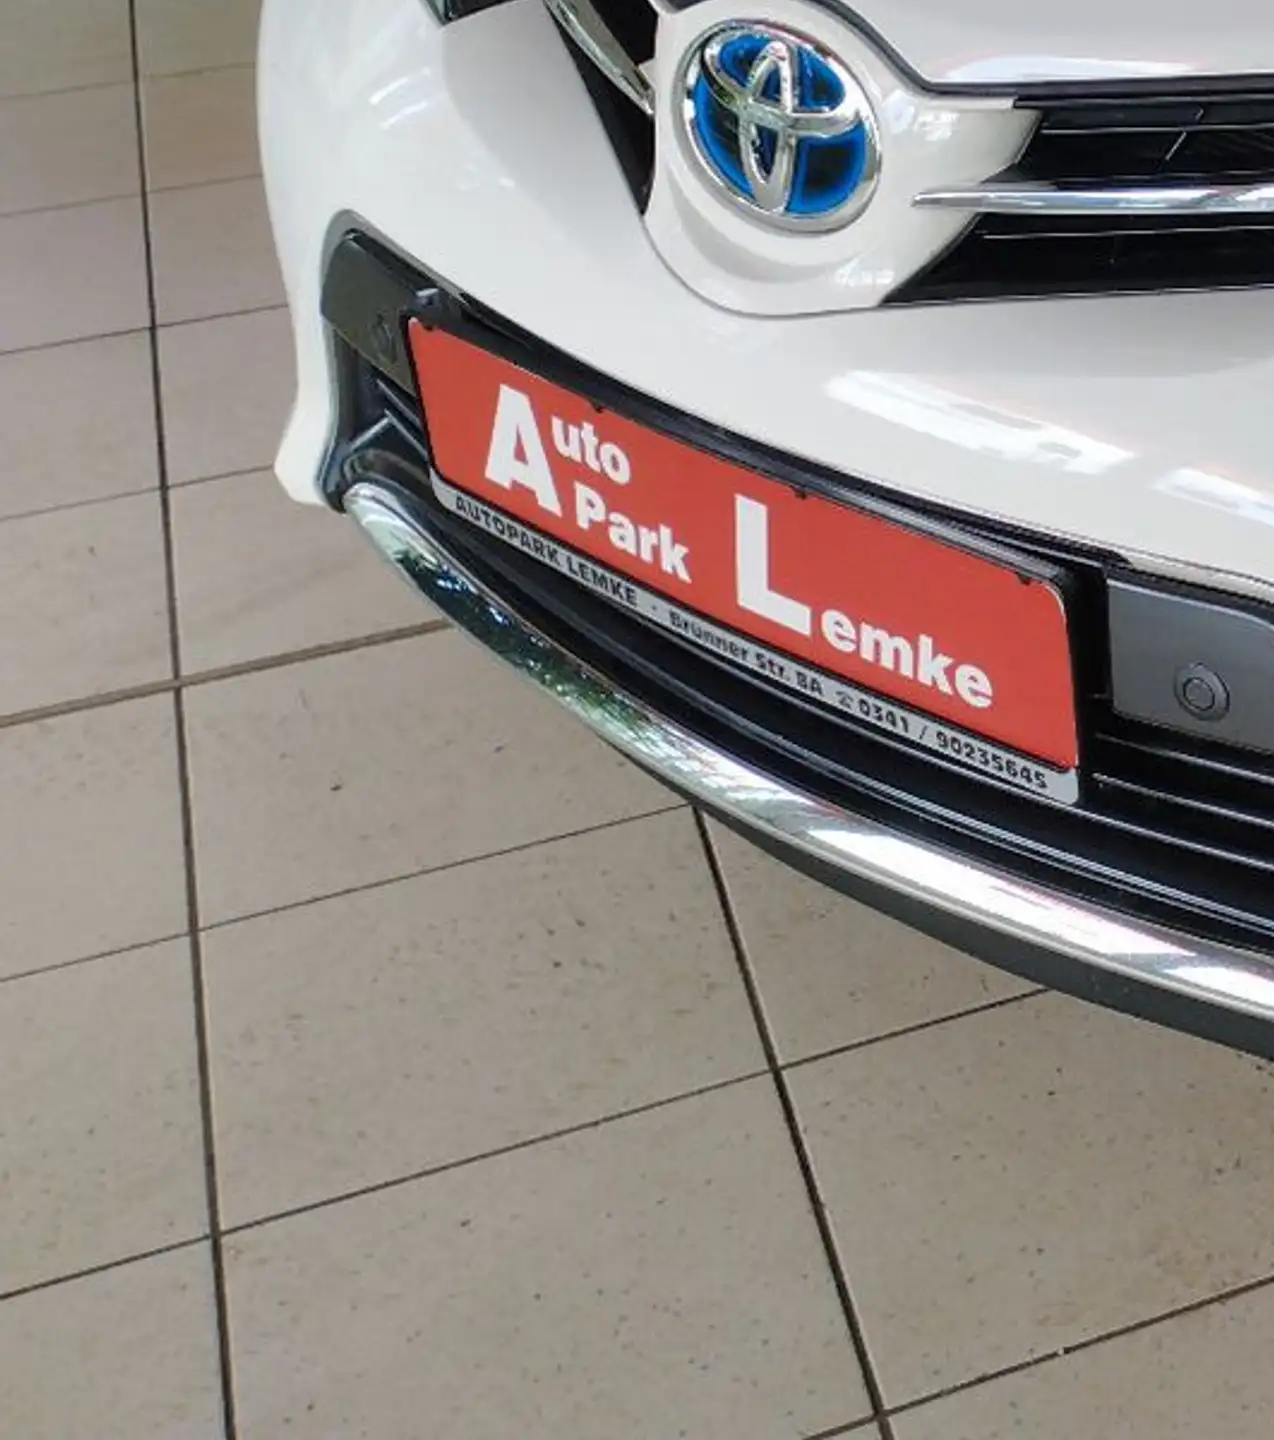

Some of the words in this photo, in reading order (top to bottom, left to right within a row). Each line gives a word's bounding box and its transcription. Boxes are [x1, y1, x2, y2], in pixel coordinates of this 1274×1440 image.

[484, 383, 631, 517] Auto
[454, 494, 562, 566] AUTOPARK
[564, 555, 640, 608] LEMKE
[858, 697, 910, 734] 0341
[934, 729, 1049, 791] 90235645
[573, 481, 692, 584] Park
[734, 492, 994, 710] Lemke
